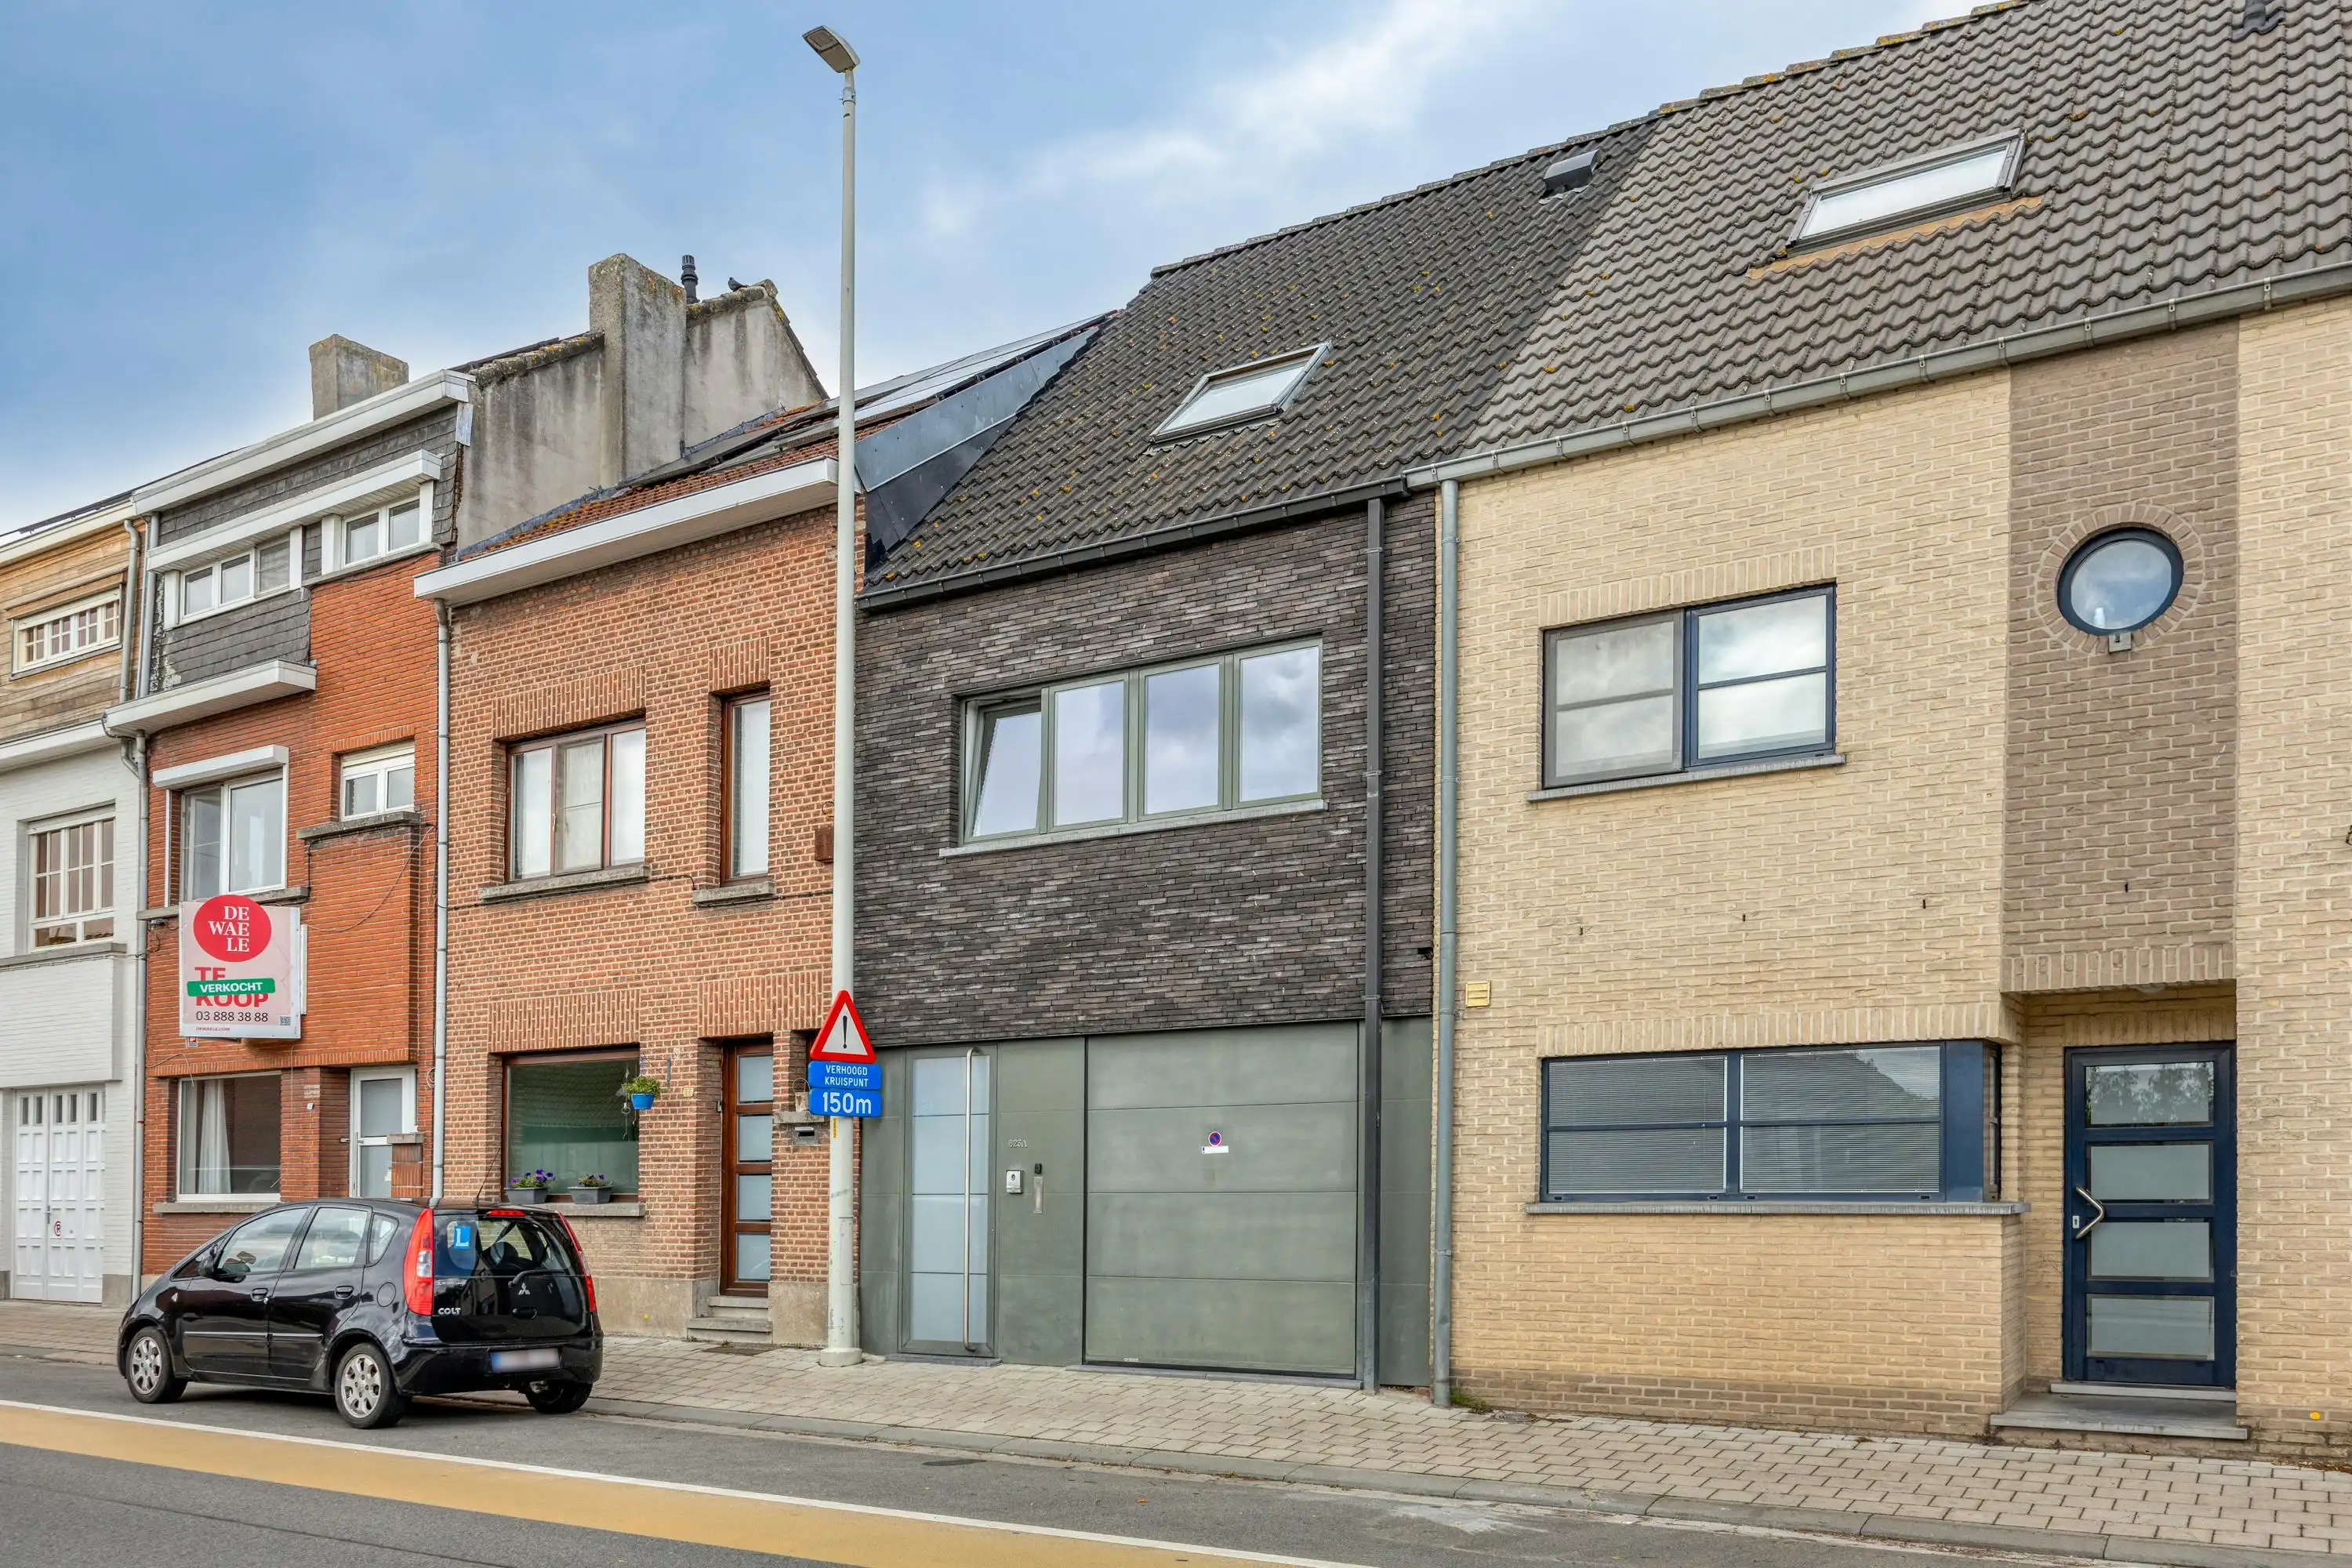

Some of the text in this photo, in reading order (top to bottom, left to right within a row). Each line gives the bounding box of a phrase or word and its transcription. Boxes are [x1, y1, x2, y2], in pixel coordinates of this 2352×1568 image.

[224, 906, 249, 921] DE
[208, 921, 249, 937] WAE
[226, 938, 249, 952] LE
[199, 982, 263, 993] VERKOCHT
[195, 993, 269, 1007] KOOP
[196, 1011, 268, 1022] 03 888 38 88
[826, 1065, 868, 1075] VERHOOGD
[825, 1076, 869, 1087] KRUISPUNT
[822, 1091, 872, 1114] 150m
[455, 1228, 469, 1247] L
[437, 1307, 462, 1316] COLT
